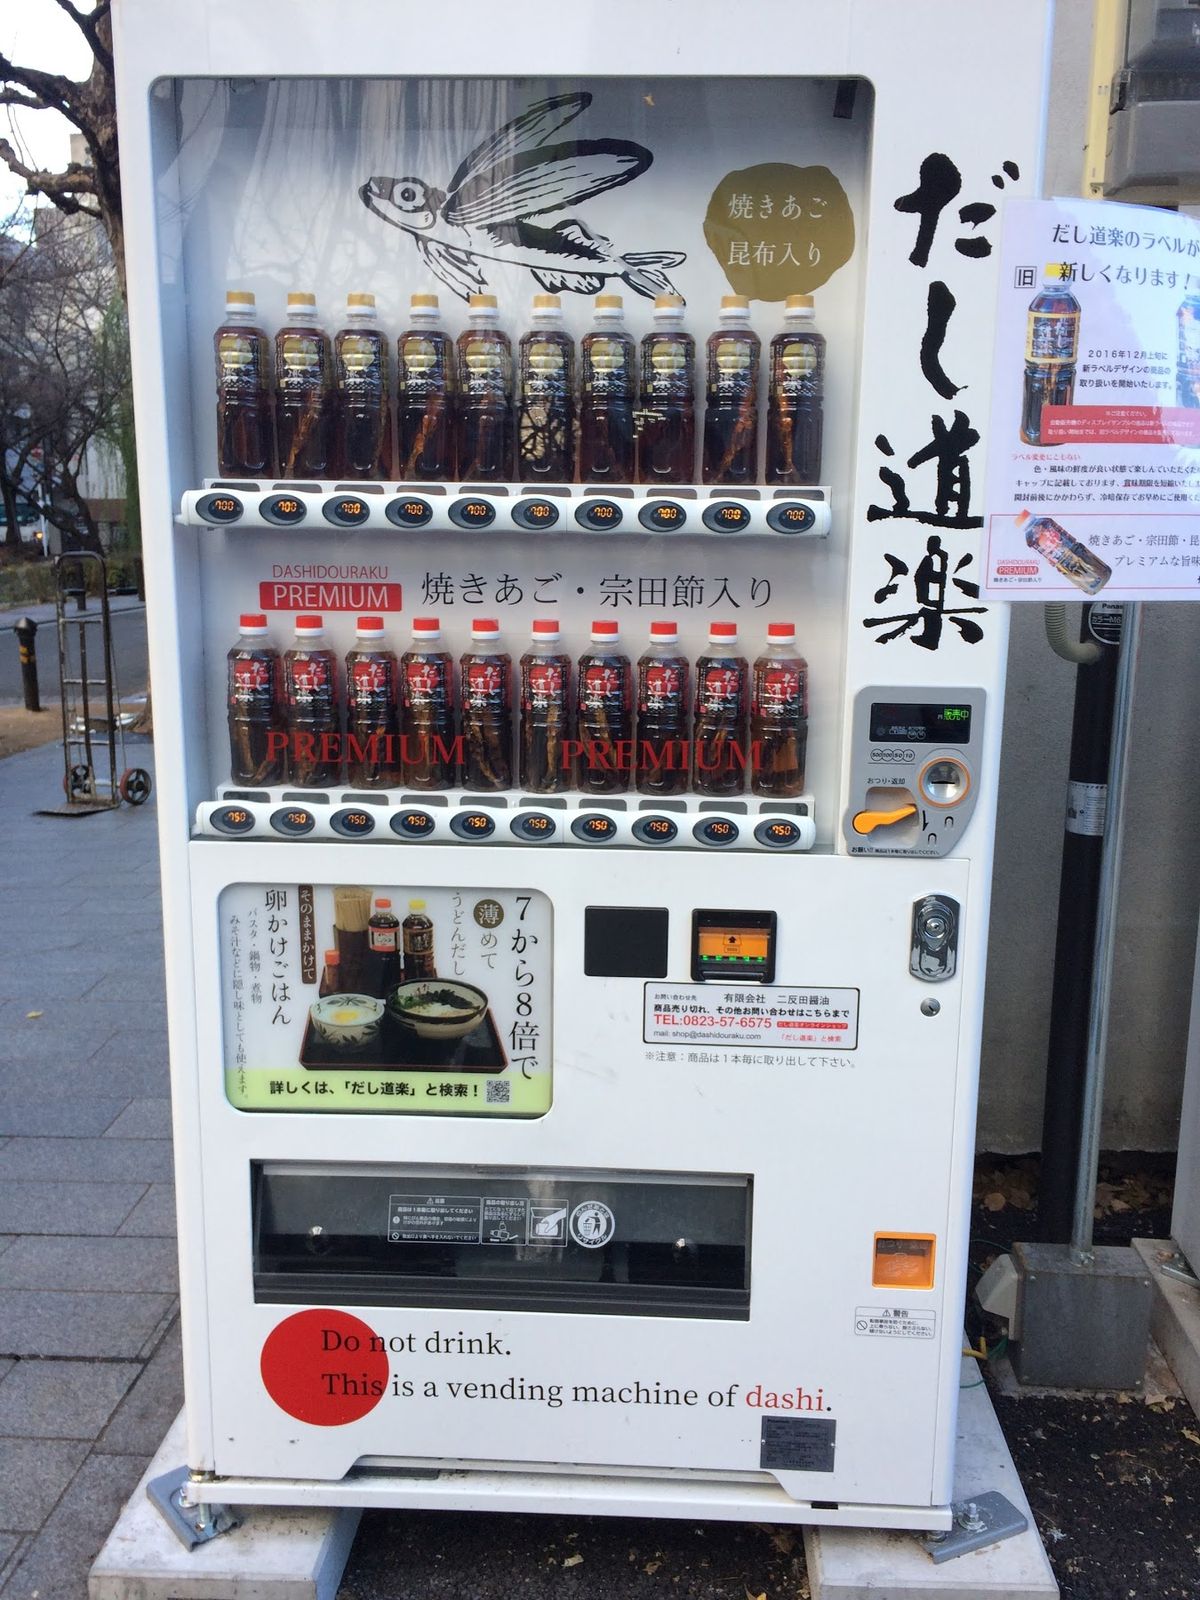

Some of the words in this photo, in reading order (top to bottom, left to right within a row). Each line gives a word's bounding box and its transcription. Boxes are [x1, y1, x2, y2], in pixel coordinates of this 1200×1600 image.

[728, 194, 827, 220] 焼きあご
[1052, 224, 1200, 257] だし道楽のラベルが
[728, 241, 821, 267] 昆布入り
[1018, 269, 1034, 286] 旧
[863, 152, 1019, 650] だし道楽
[215, 500, 234, 511] 700
[278, 501, 297, 512] 700
[341, 503, 360, 513] 700
[404, 504, 423, 515] 700
[467, 505, 486, 516] 700
[530, 506, 549, 517] 700
[594, 507, 613, 518] 700
[658, 508, 677, 519] 700
[721, 509, 741, 520] 700
[786, 510, 804, 520] 700
[273, 565, 389, 580] DASHIDOURAKU
[999, 567, 1037, 575] PREMIUM
[273, 584, 389, 608] PREMIUM
[421, 573, 771, 608] 焼きあご・宗田節入り
[267, 732, 465, 765] PREMIUM
[561, 739, 764, 770] PREMIUM
[227, 812, 246, 822] 750
[288, 813, 306, 823] 750
[348, 814, 366, 825] 750
[408, 816, 426, 826] 750
[468, 817, 487, 827] 750
[528, 818, 547, 828] 750
[589, 820, 607, 830] 750
[650, 822, 668, 832] 750
[711, 823, 729, 834] 750
[772, 825, 790, 836] 750
[300, 888, 316, 980] そのままかけて
[452, 892, 466, 976] うどんだし
[478, 902, 500, 969] 薄めて
[265, 889, 291, 1026] 卵かけごはん
[508, 896, 539, 1080] 7から8倍で
[724, 993, 766, 1004] 有限会社
[654, 1014, 772, 1028] TEL:0823-57-6575
[654, 1030, 671, 1038] mail:
[672, 1030, 761, 1041] shop@dashidouraku.com
[321, 1329, 360, 1353] Do
[369, 1332, 416, 1355] not
[424, 1331, 511, 1356] drink.
[321, 1371, 384, 1397] This
[391, 1375, 415, 1398] is
[423, 1383, 439, 1399] a
[447, 1377, 563, 1407] vending
[572, 1381, 699, 1407] machine
[707, 1384, 740, 1408] of
[746, 1386, 833, 1412] dashi.
